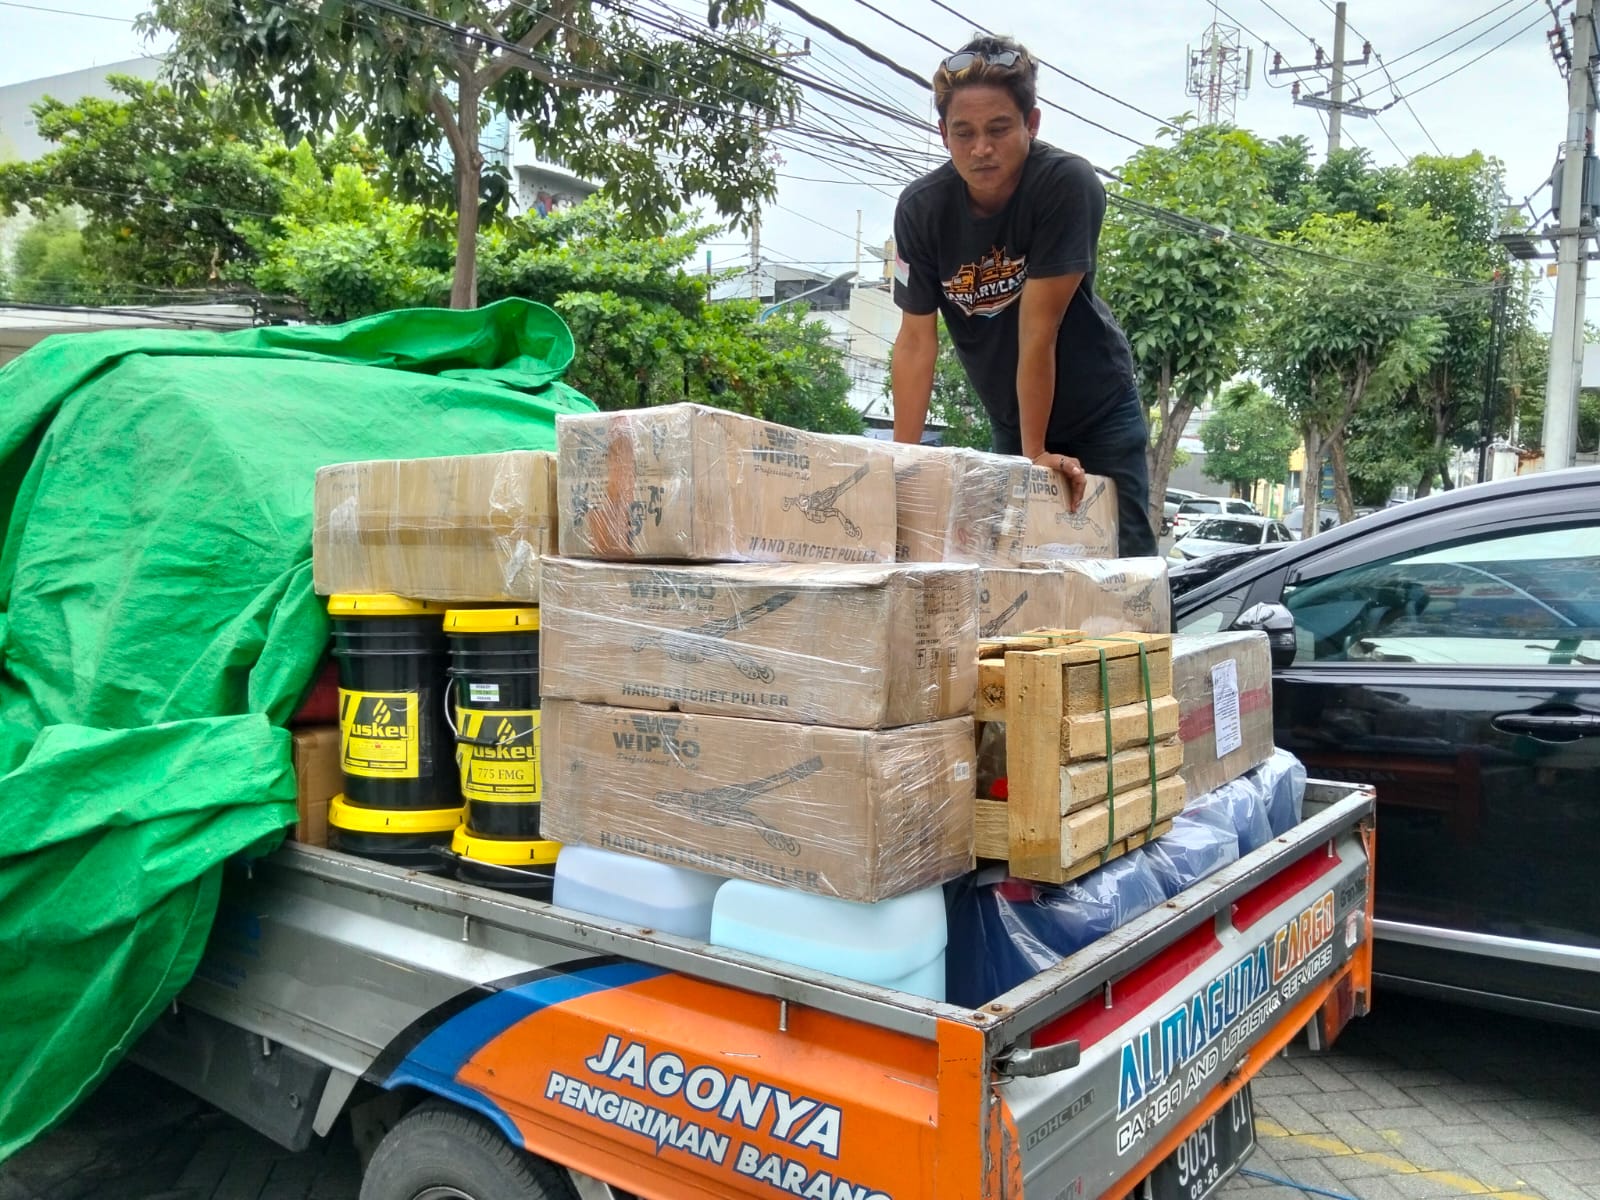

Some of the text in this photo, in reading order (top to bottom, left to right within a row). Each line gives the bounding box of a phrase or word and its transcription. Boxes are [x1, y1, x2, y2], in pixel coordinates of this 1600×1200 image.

[749, 536, 876, 562] HAND RATCHET PULLER
[622, 683, 789, 707] HAND RATCHET PULLER
[612, 732, 700, 759] WIPRO
[478, 768, 524, 780] 775 FMG
[600, 831, 818, 887] HAND RATCHET PULLER
[1116, 889, 1335, 1122] ALMAGUNA CARGO
[1117, 1080, 1182, 1157] CARGO
[1184, 1046, 1219, 1100] AND
[1281, 944, 1333, 1001] SERVICES
[585, 1034, 842, 1160] JAGONYA
[545, 1072, 893, 1200] PENGIRIMAN BARAN
[1027, 1106, 1071, 1151] DOHC
[1177, 1114, 1216, 1187] 9057
